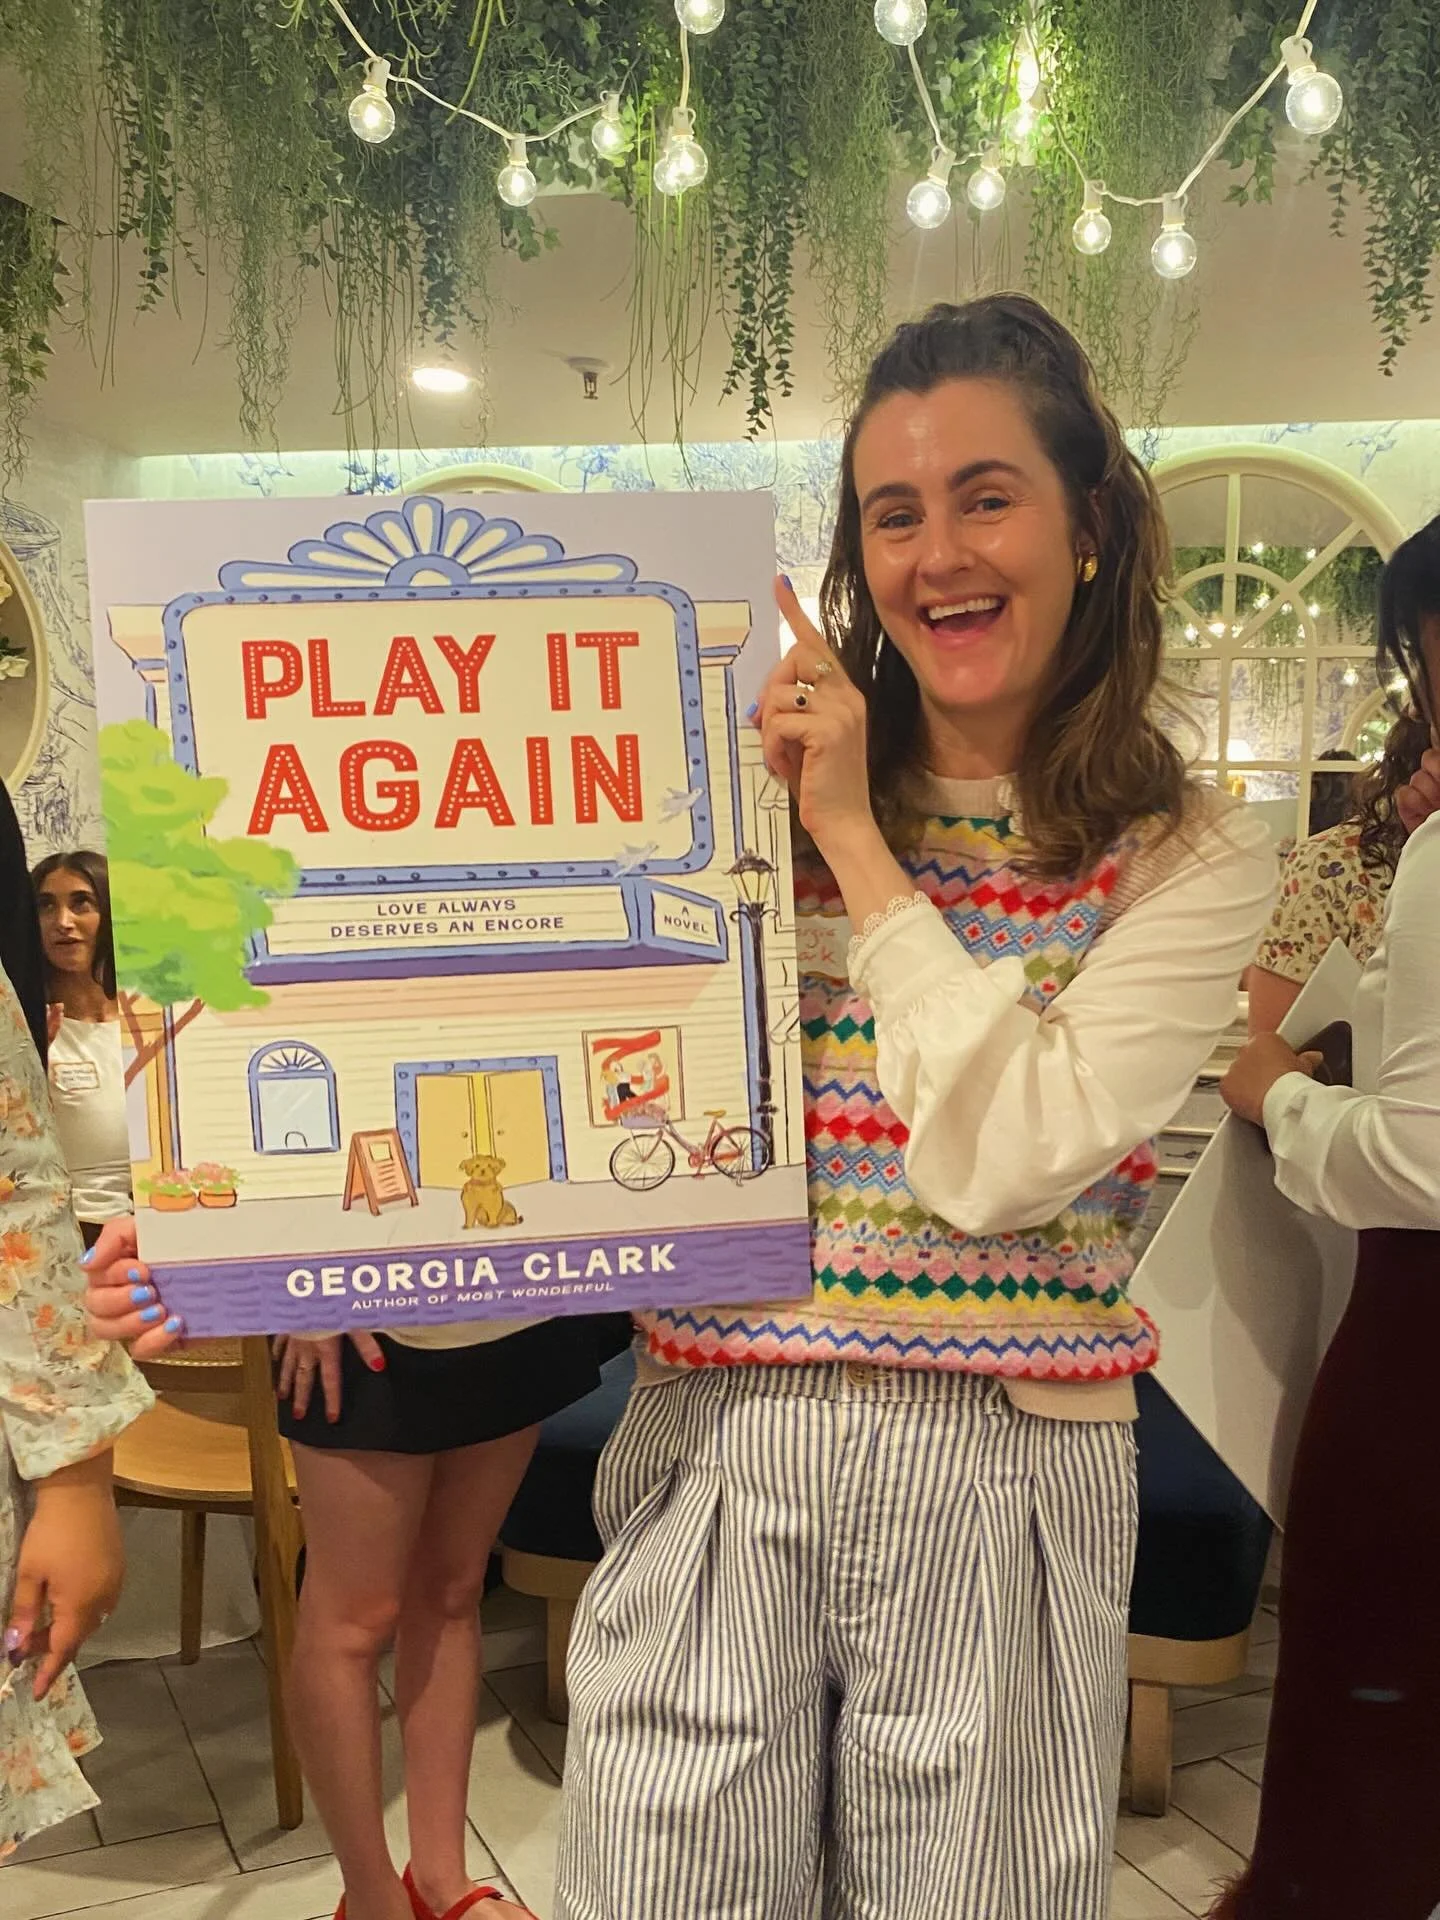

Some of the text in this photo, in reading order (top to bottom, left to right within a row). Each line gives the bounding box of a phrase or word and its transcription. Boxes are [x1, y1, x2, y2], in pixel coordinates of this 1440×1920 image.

[242, 632, 639, 719] PLAY IT
[248, 734, 642, 834] AGAIN
[377, 899, 516, 916] LOVE ALWAYS
[681, 905, 690, 917] A
[331, 917, 564, 938] DESERVES AN ENCORE
[663, 914, 709, 934] NOVEL
[286, 1242, 676, 1298] GEORGIA CLARK
[351, 1282, 616, 1311] AUTHOR OF MOST WONDERFUL
